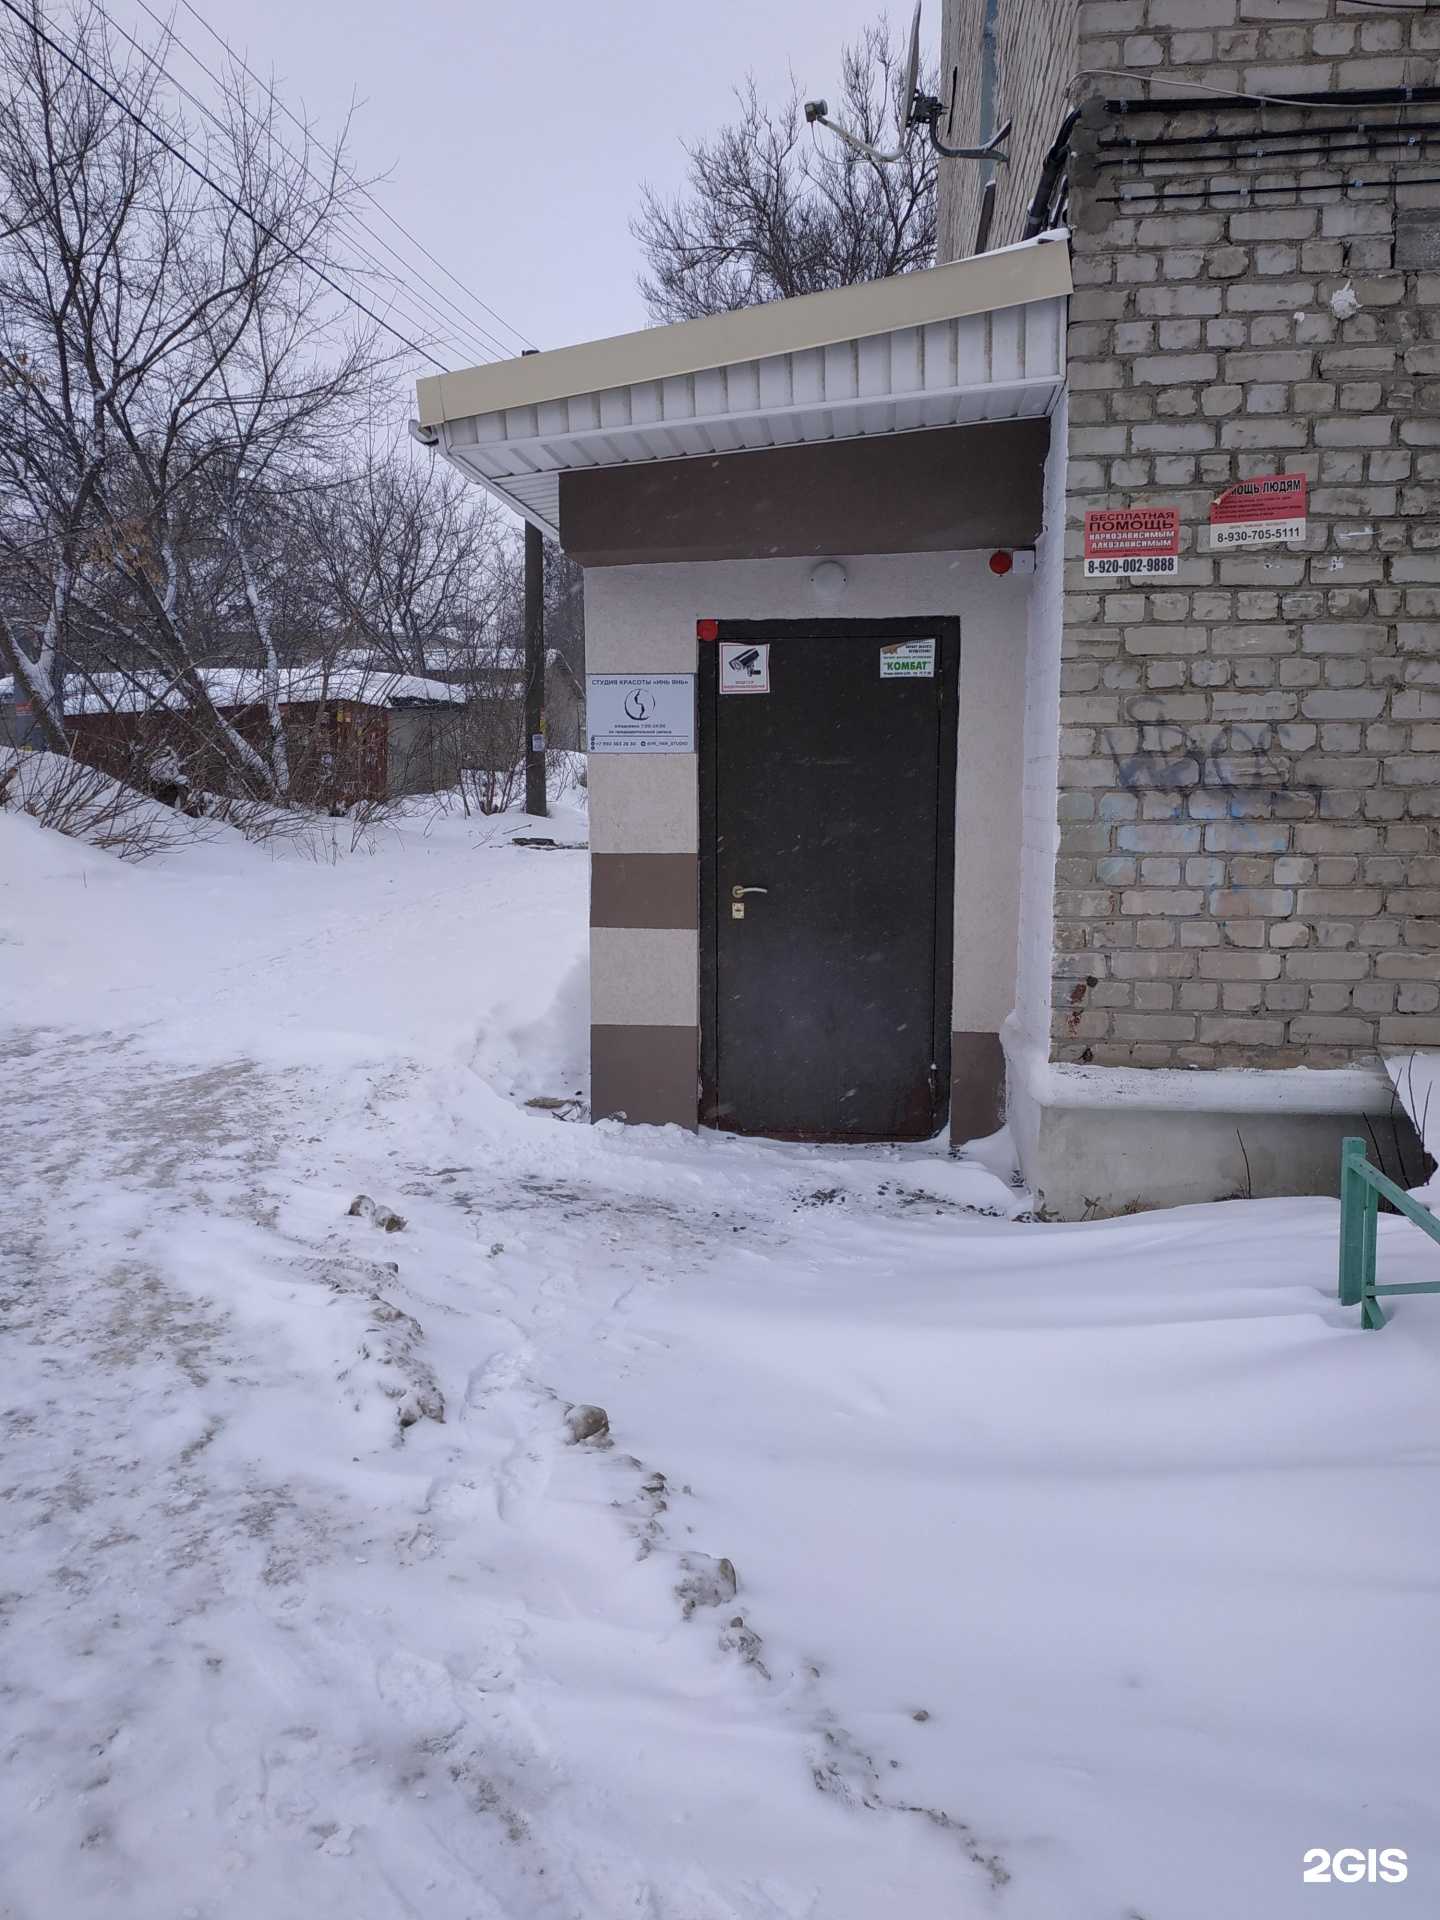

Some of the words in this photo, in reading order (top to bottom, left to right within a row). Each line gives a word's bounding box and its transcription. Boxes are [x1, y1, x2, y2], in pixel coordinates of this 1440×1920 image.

[1262, 480, 1301, 493] ЛЮДЯМ
[1090, 512, 1175, 522] БЕСПЛАТНАЯ
[1089, 520, 1174, 531] ПОМОЩЬ
[1089, 530, 1175, 540] НАРКОЗАВИСИМЫМ
[1217, 527, 1300, 543] 8-930-705-5111
[1091, 540, 1172, 549] АЛКОЗАВИСИМЫМ
[1088, 558, 1174, 574] 8-920-002-9888
